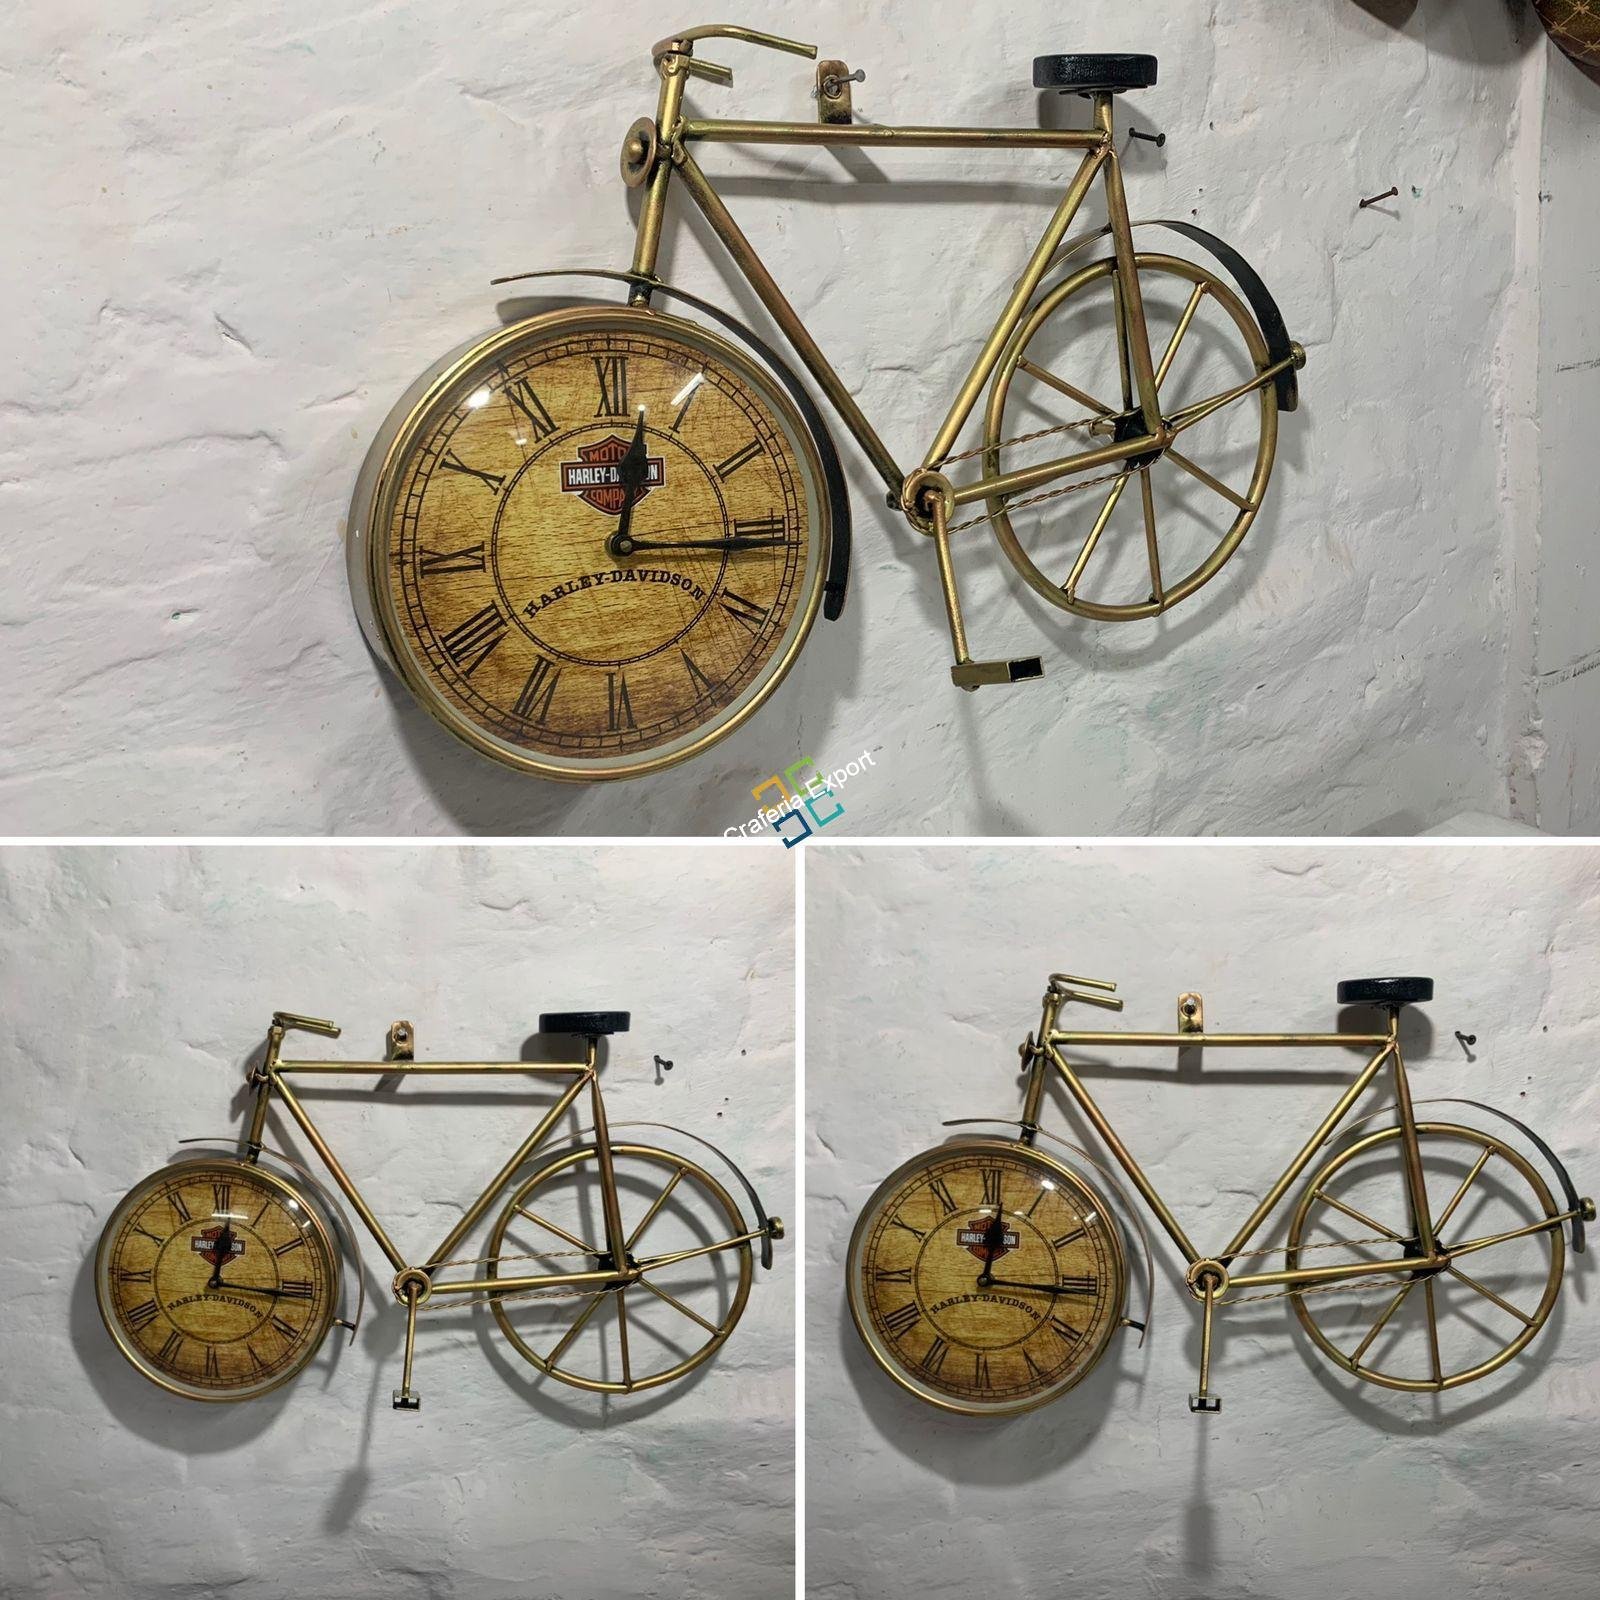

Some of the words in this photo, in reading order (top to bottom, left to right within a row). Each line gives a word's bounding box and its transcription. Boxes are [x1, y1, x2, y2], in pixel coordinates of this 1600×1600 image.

[591, 355, 630, 418] XII
[503, 376, 558, 443] XI
[589, 442, 629, 462] MOTO
[713, 436, 766, 483] II
[440, 448, 506, 495] X
[568, 465, 658, 485] HARLEY-DN
[591, 488, 637, 508] COMPA
[419, 541, 487, 578] IX
[522, 570, 704, 619] HARLEY-DAVIDSON
[929, 1178, 959, 1216] XI
[979, 1169, 1003, 1205] XII
[167, 1192, 192, 1225] XI
[133, 1223, 164, 1246] X
[890, 1214, 926, 1242] X
[1051, 1227, 1088, 1250] II
[273, 1237, 305, 1257] II
[168, 1294, 263, 1320] HARLEY-DAVIDSON
[930, 1294, 1042, 1321] HARLEY-DAVIDSON
